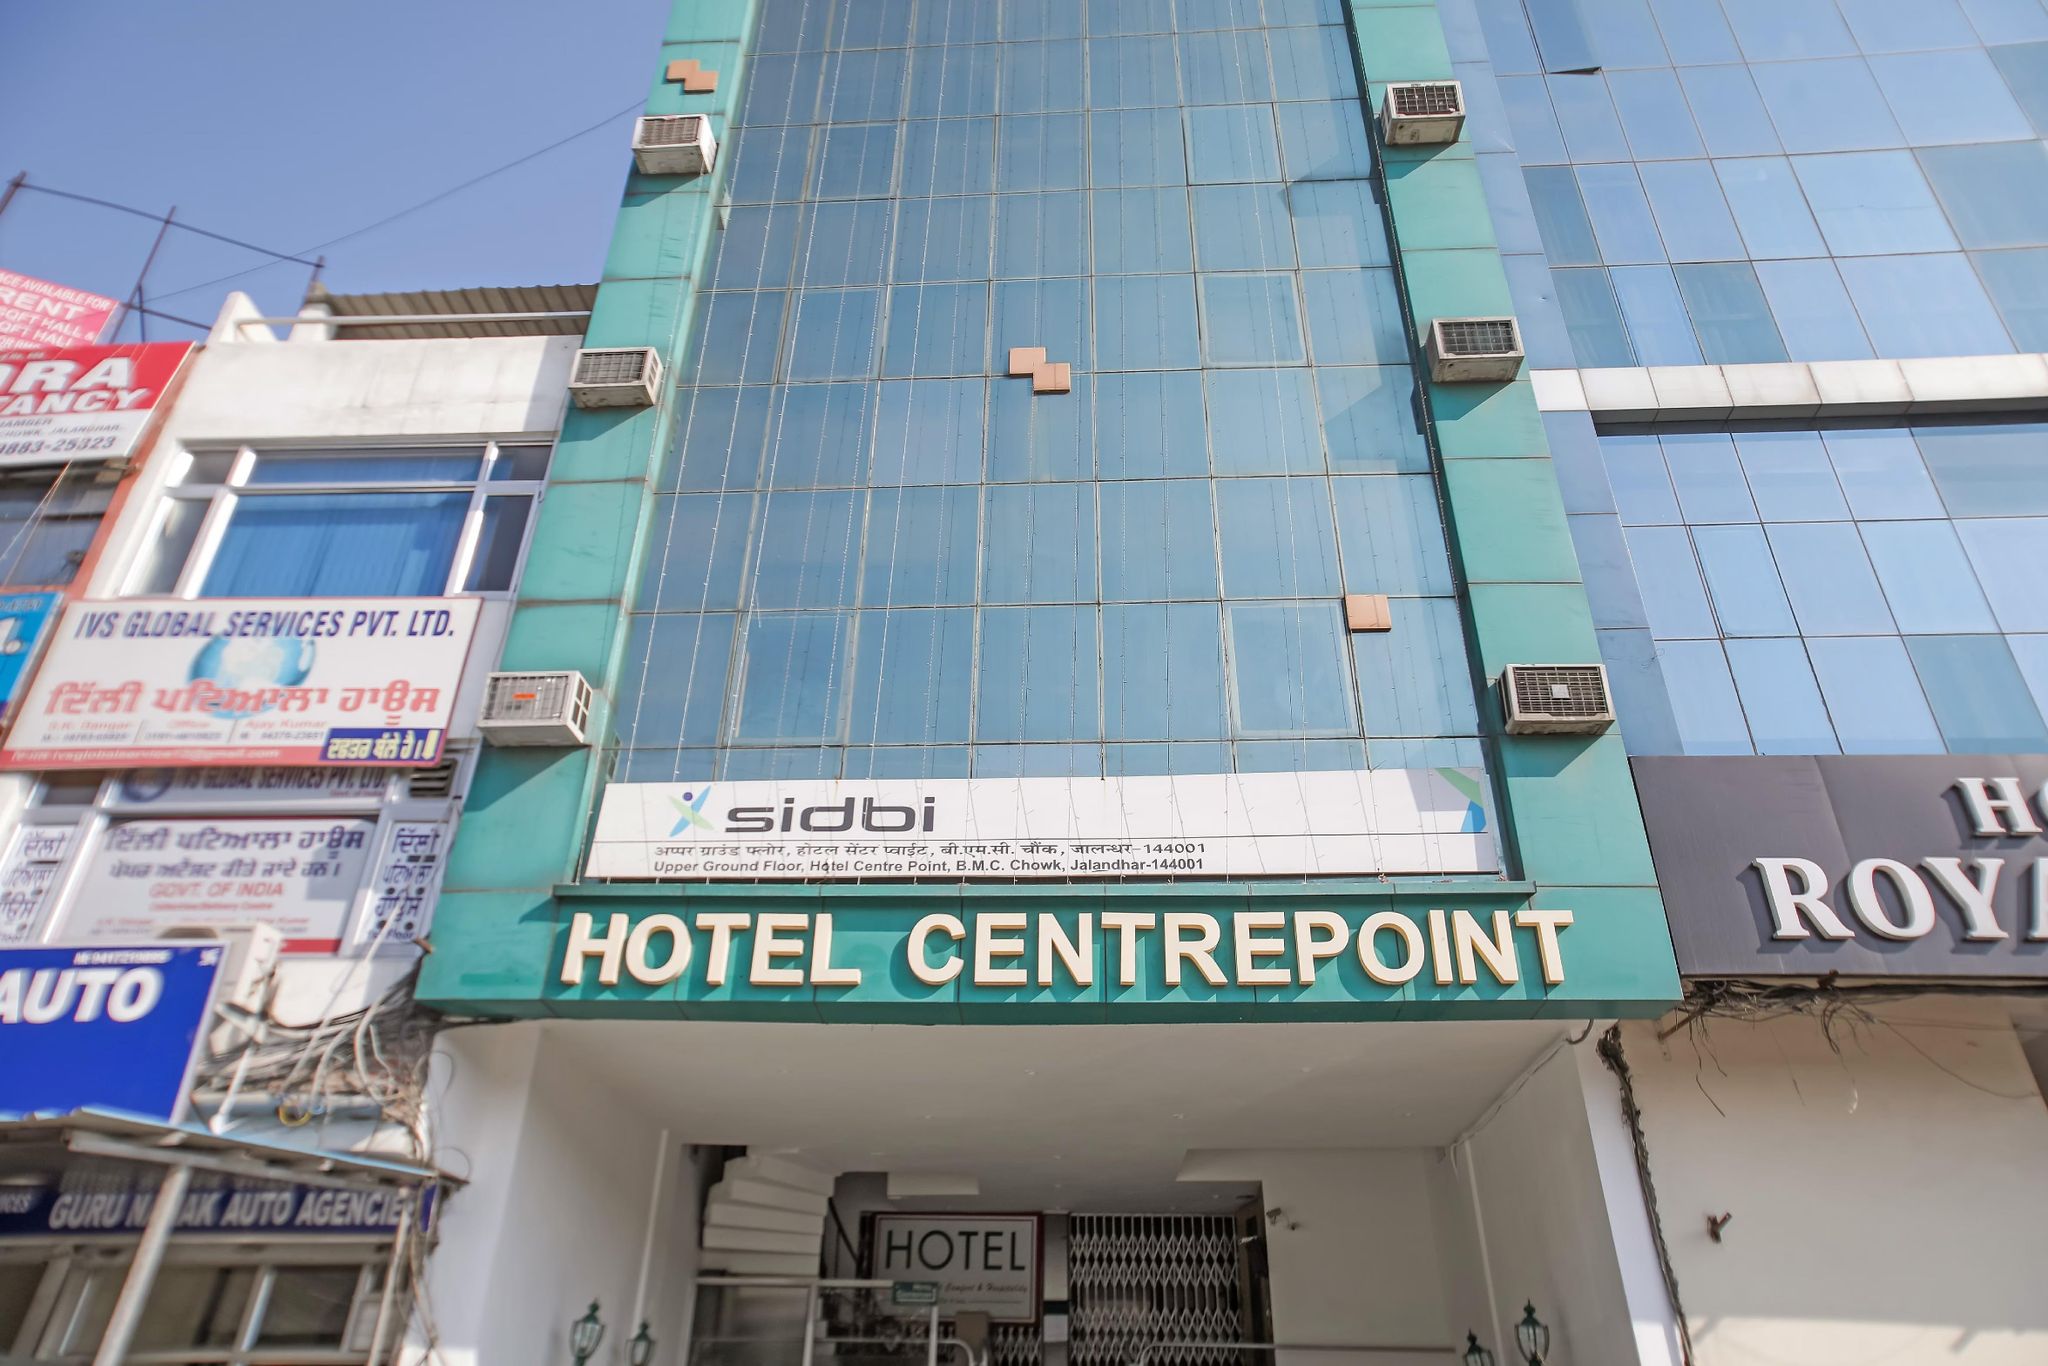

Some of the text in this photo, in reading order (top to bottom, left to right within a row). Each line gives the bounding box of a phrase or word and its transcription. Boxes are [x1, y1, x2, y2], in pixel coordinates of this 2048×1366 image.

[84, 292, 110, 311] FOR
[0, 357, 132, 393] RA
[74, 609, 455, 639] IVS GLOBAL SERVICES PVT. LTD.
[43, 679, 440, 726] ਦਿੱਲੀ ਪਟਿਆਲਾ ਹਾਊਸ
[724, 797, 936, 833] sidbi
[1950, 776, 2048, 837] H
[106, 825, 365, 860] ਦਿੱਲੀ ਪਟਿਆਲਾ ਹਾਊਸ
[654, 845, 693, 857] अप्पर
[700, 843, 741, 857] ग्राउंड
[746, 844, 791, 858] फ्लोर,
[796, 844, 839, 857] होटल
[844, 843, 880, 856] सेंटर
[654, 858, 1203, 875] Upper Ground Floor, Hotel Centre Point, B.M.C. Chowk, Jalandhar-144001
[207, 882, 233, 897] OF
[236, 882, 284, 897] INDIA
[560, 910, 1574, 987] HOTEL CENTREPOINT
[0, 966, 164, 1024] AUTO
[49, 1192, 127, 1229] GURU
[220, 1191, 292, 1225] AUTO
[884, 1229, 1027, 1273] HOTEL
